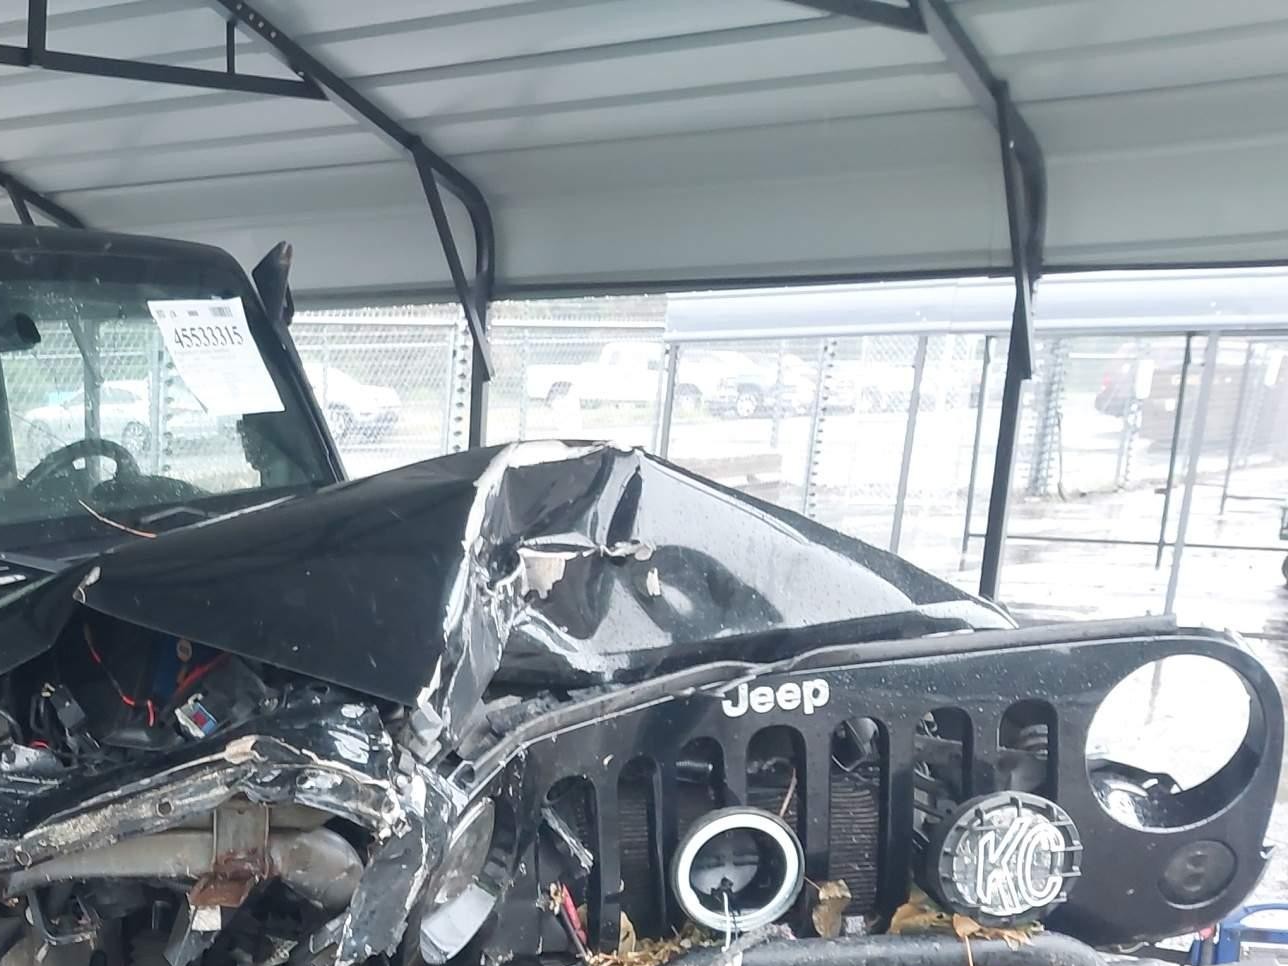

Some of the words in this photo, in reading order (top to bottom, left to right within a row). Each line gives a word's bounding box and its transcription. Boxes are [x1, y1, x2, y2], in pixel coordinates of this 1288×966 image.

[174, 326, 244, 349] 45533315
[721, 679, 830, 718] Jeep
[976, 814, 1065, 912] KC
